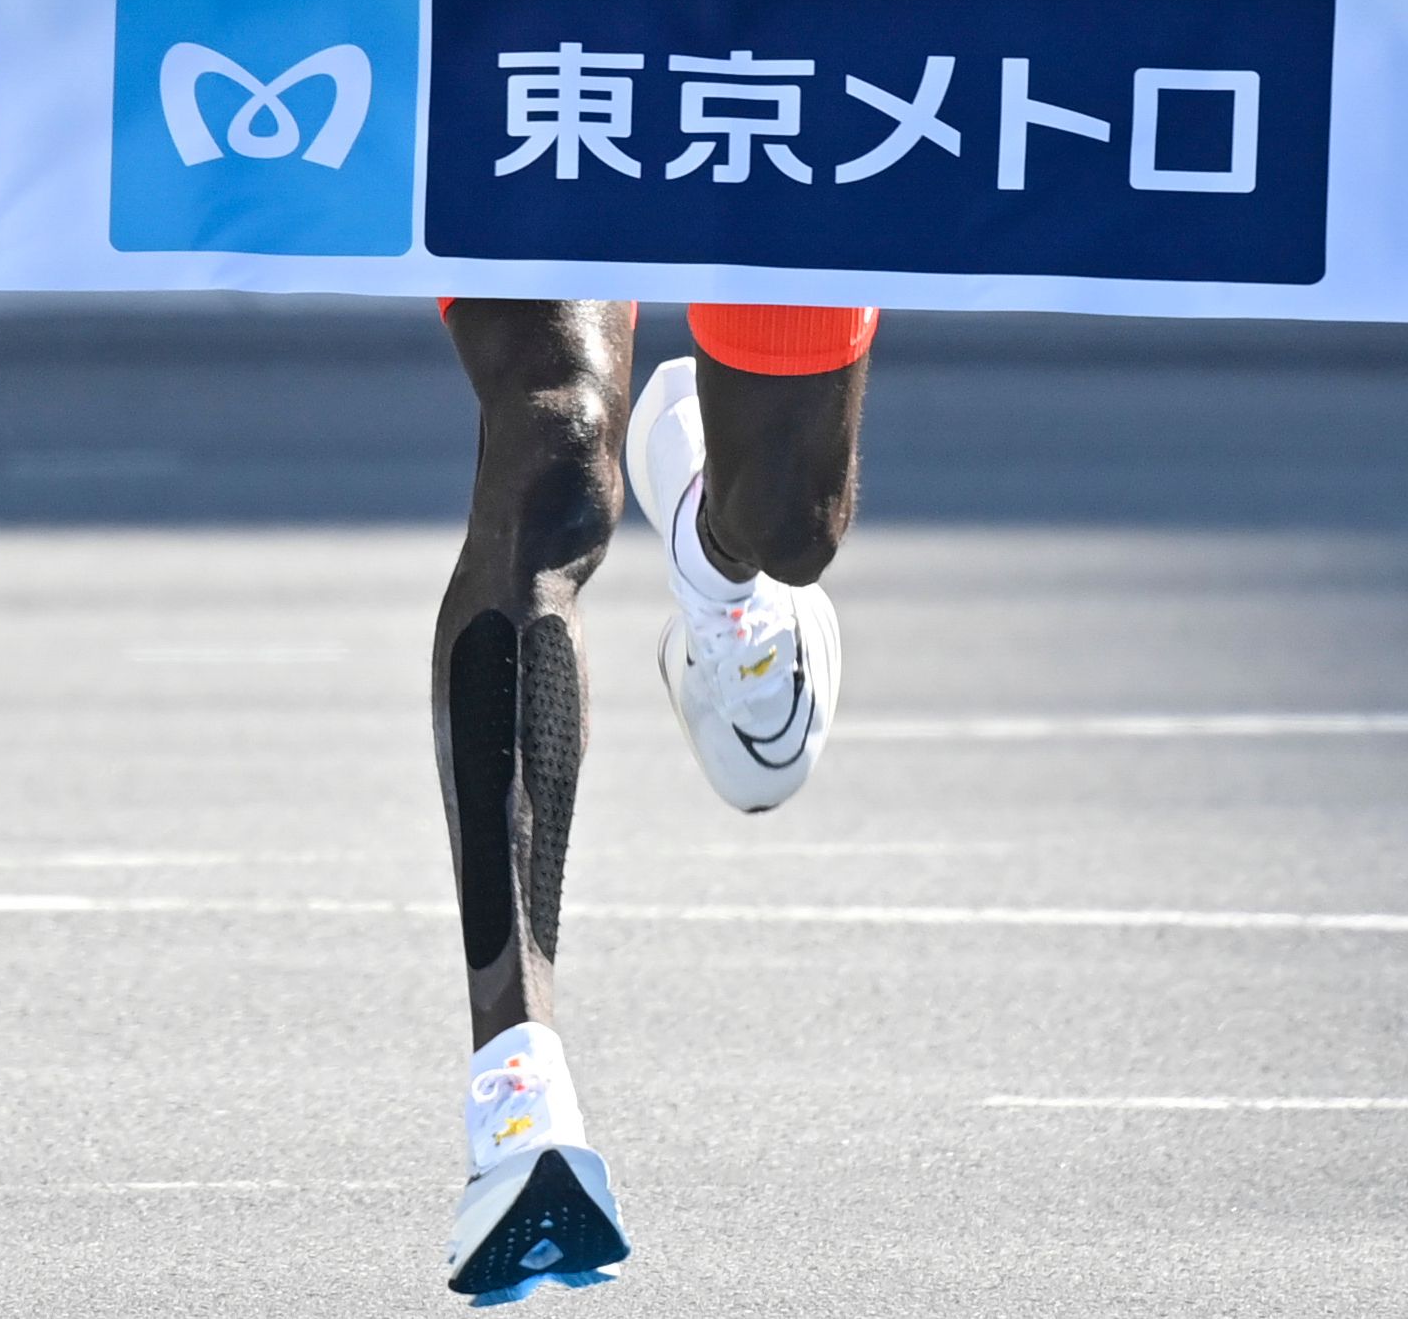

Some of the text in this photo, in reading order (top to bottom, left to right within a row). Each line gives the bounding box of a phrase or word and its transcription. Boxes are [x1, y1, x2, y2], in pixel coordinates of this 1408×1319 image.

[493, 41, 1261, 194] 東京メトロ
